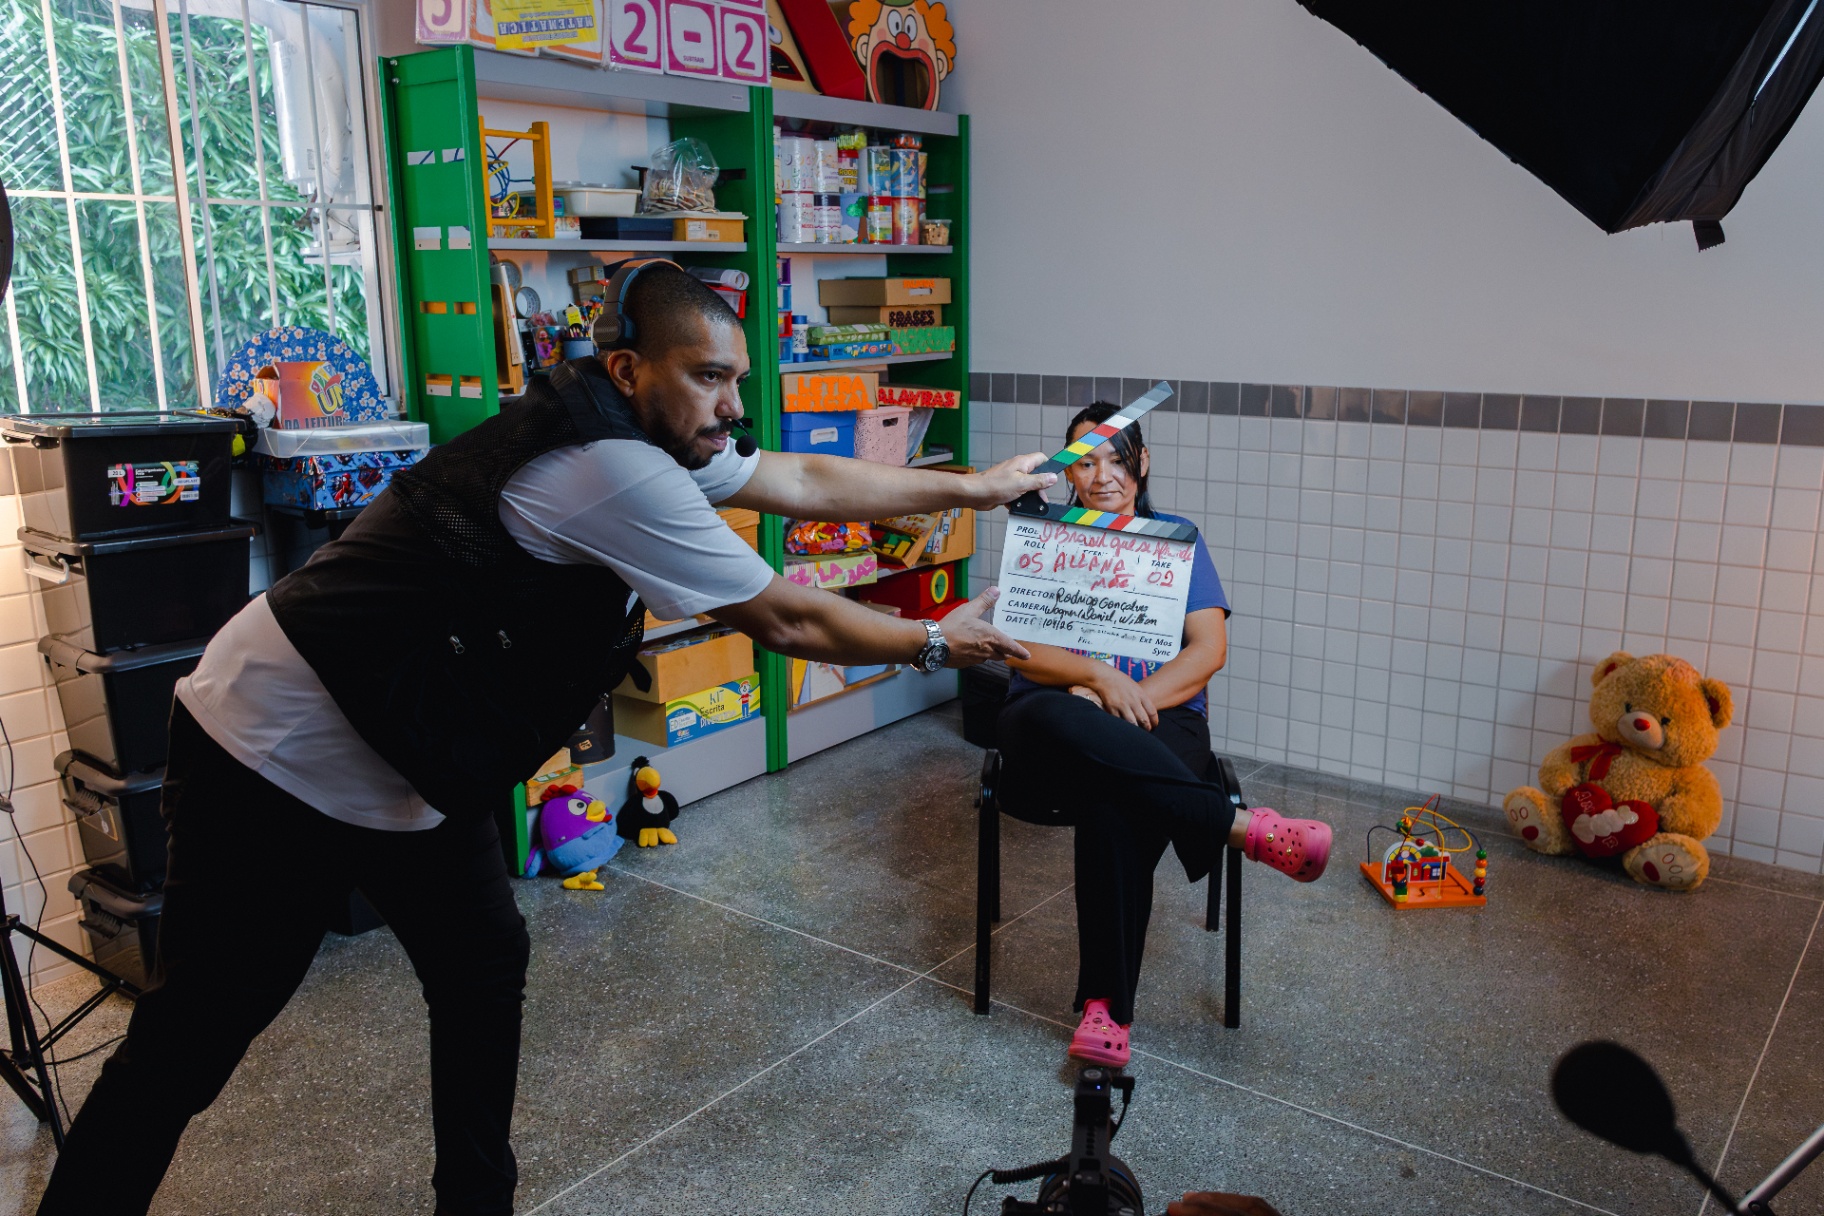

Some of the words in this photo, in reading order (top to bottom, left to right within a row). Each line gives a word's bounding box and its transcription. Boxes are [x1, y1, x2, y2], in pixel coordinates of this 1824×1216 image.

[623, 3, 648, 55] 2
[735, 22, 756, 71] 2
[889, 310, 935, 327] FRASES
[797, 375, 866, 395] LETRA
[785, 393, 873, 413] INICIAL
[878, 387, 955, 408] ALAVRAS
[1110, 536, 1137, 557] que
[1053, 552, 1125, 574] ALLANA
[1151, 560, 1172, 569] TAKE
[1147, 570, 1174, 587] 02
[1009, 586, 1055, 599] DIRECTOR
[1055, 587, 1098, 608] Rodrigo
[1007, 599, 1045, 611] CAMERA
[1005, 615, 1028, 625] DATE
[1139, 635, 1153, 644] Ext
[1154, 638, 1173, 647] Mos
[1151, 647, 1171, 656] Sync
[709, 689, 725, 705] KIT
[699, 704, 725, 717] Escrita
